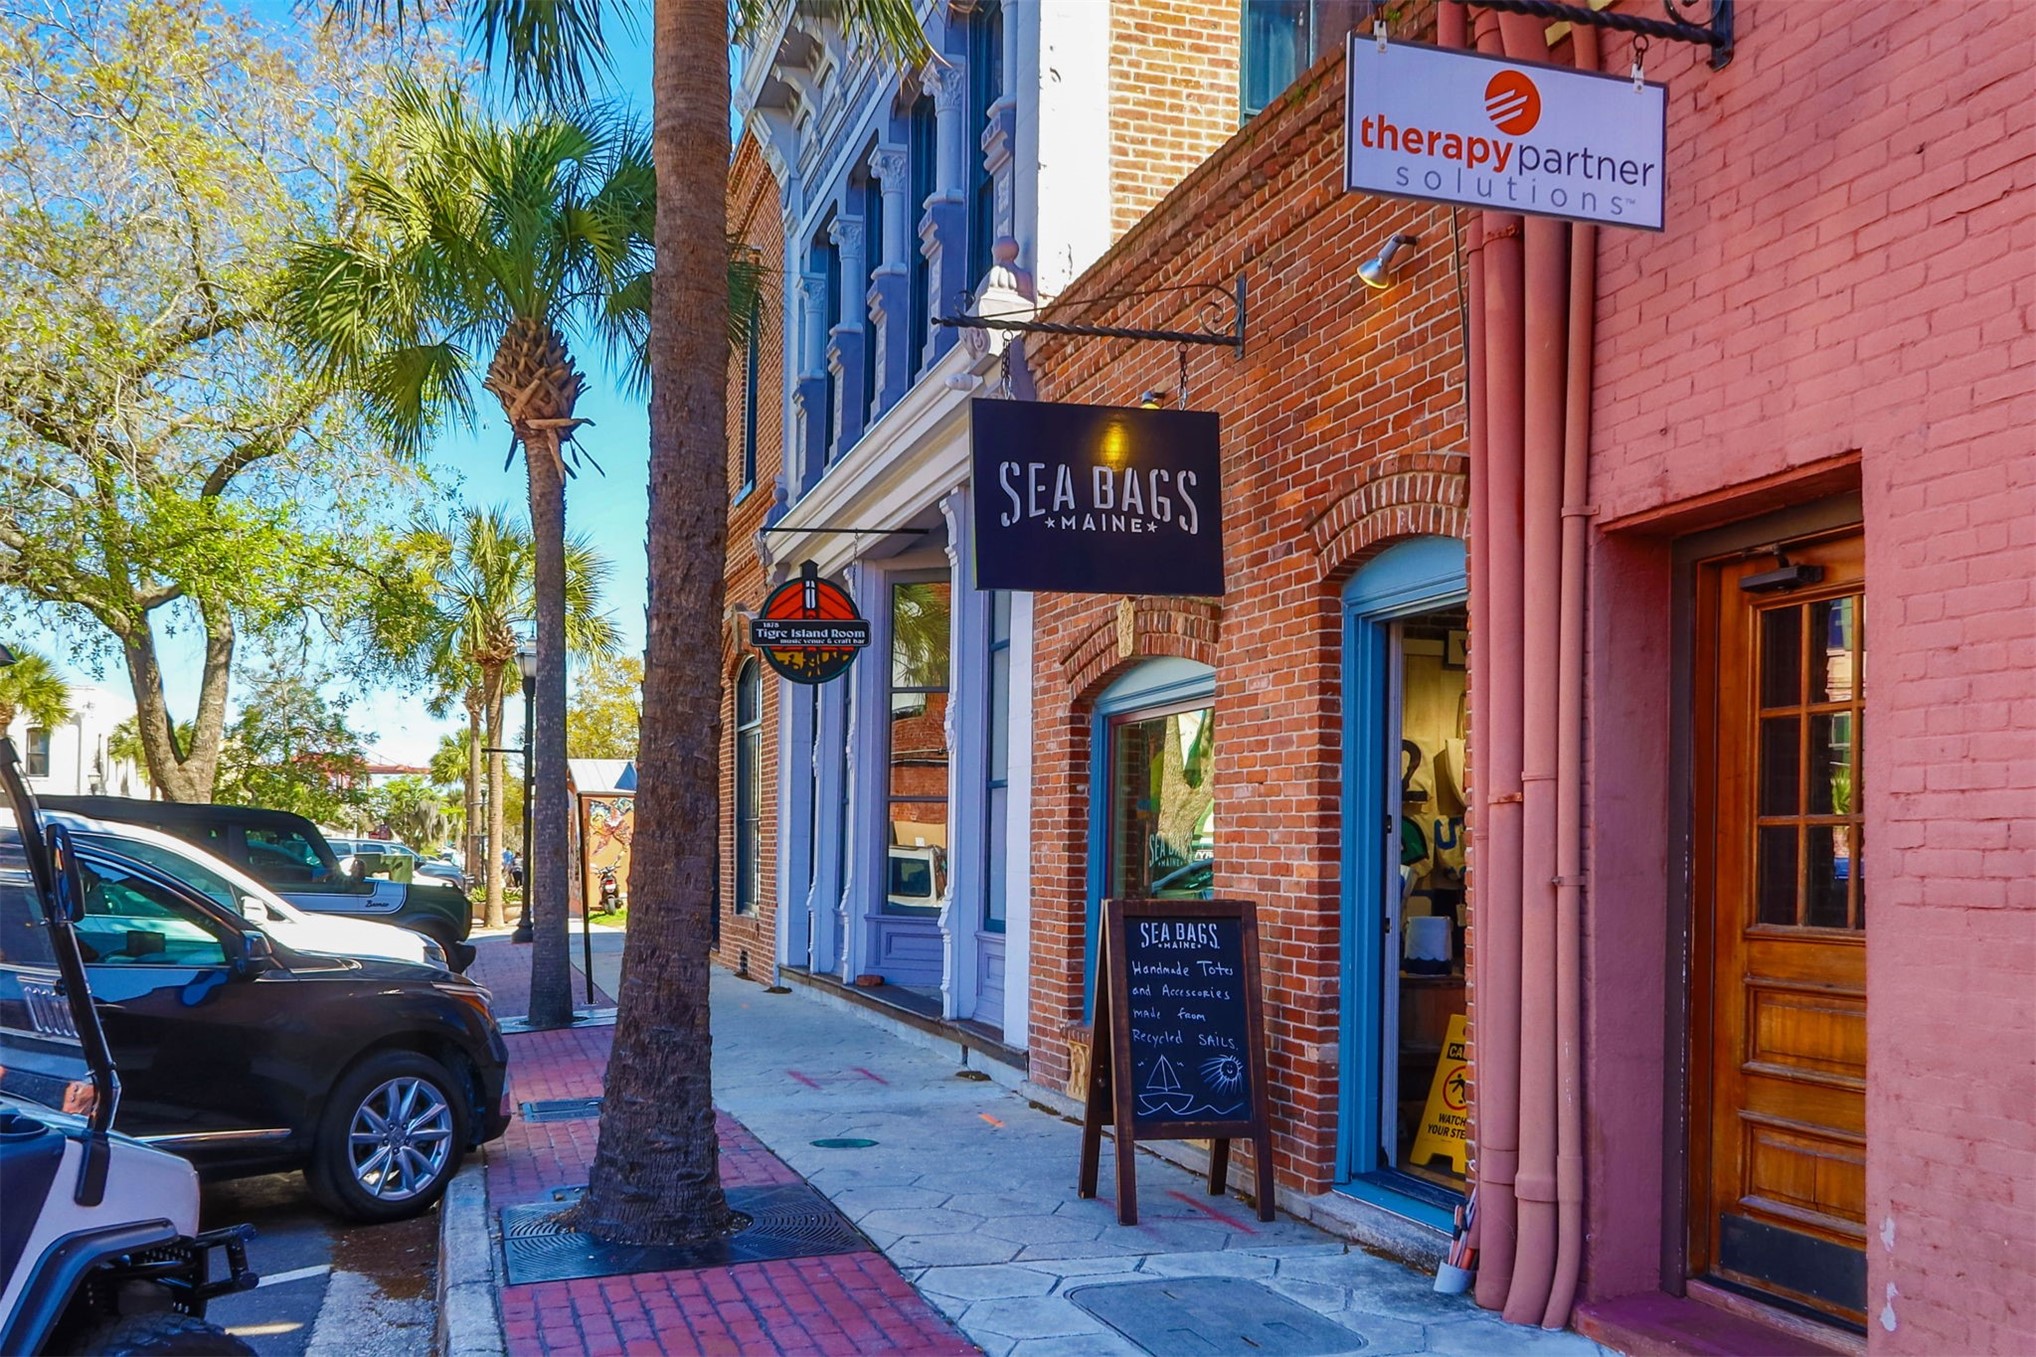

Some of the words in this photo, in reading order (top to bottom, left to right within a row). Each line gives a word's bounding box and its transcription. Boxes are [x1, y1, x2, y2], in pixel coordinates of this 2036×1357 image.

[999, 461, 1075, 528] SEA
[1092, 465, 1199, 535] BAGS
[1061, 513, 1143, 533] MAINE
[756, 628, 788, 640] Tigre
[791, 628, 828, 638] Island
[831, 629, 865, 638] Room
[1140, 922, 1170, 948] SEA
[1175, 922, 1218, 949] BAGS
[1163, 941, 1196, 949] MAINE
[1131, 960, 1190, 977] Handmade
[1196, 960, 1234, 977] Totes
[1132, 984, 1151, 997] and
[1177, 1007, 1206, 1022] from
[1132, 1029, 1183, 1048] Recycled
[1438, 1113, 1467, 1127] WATCH
[1427, 1123, 1450, 1137] YOUR
[1450, 1127, 1466, 1140] STE
